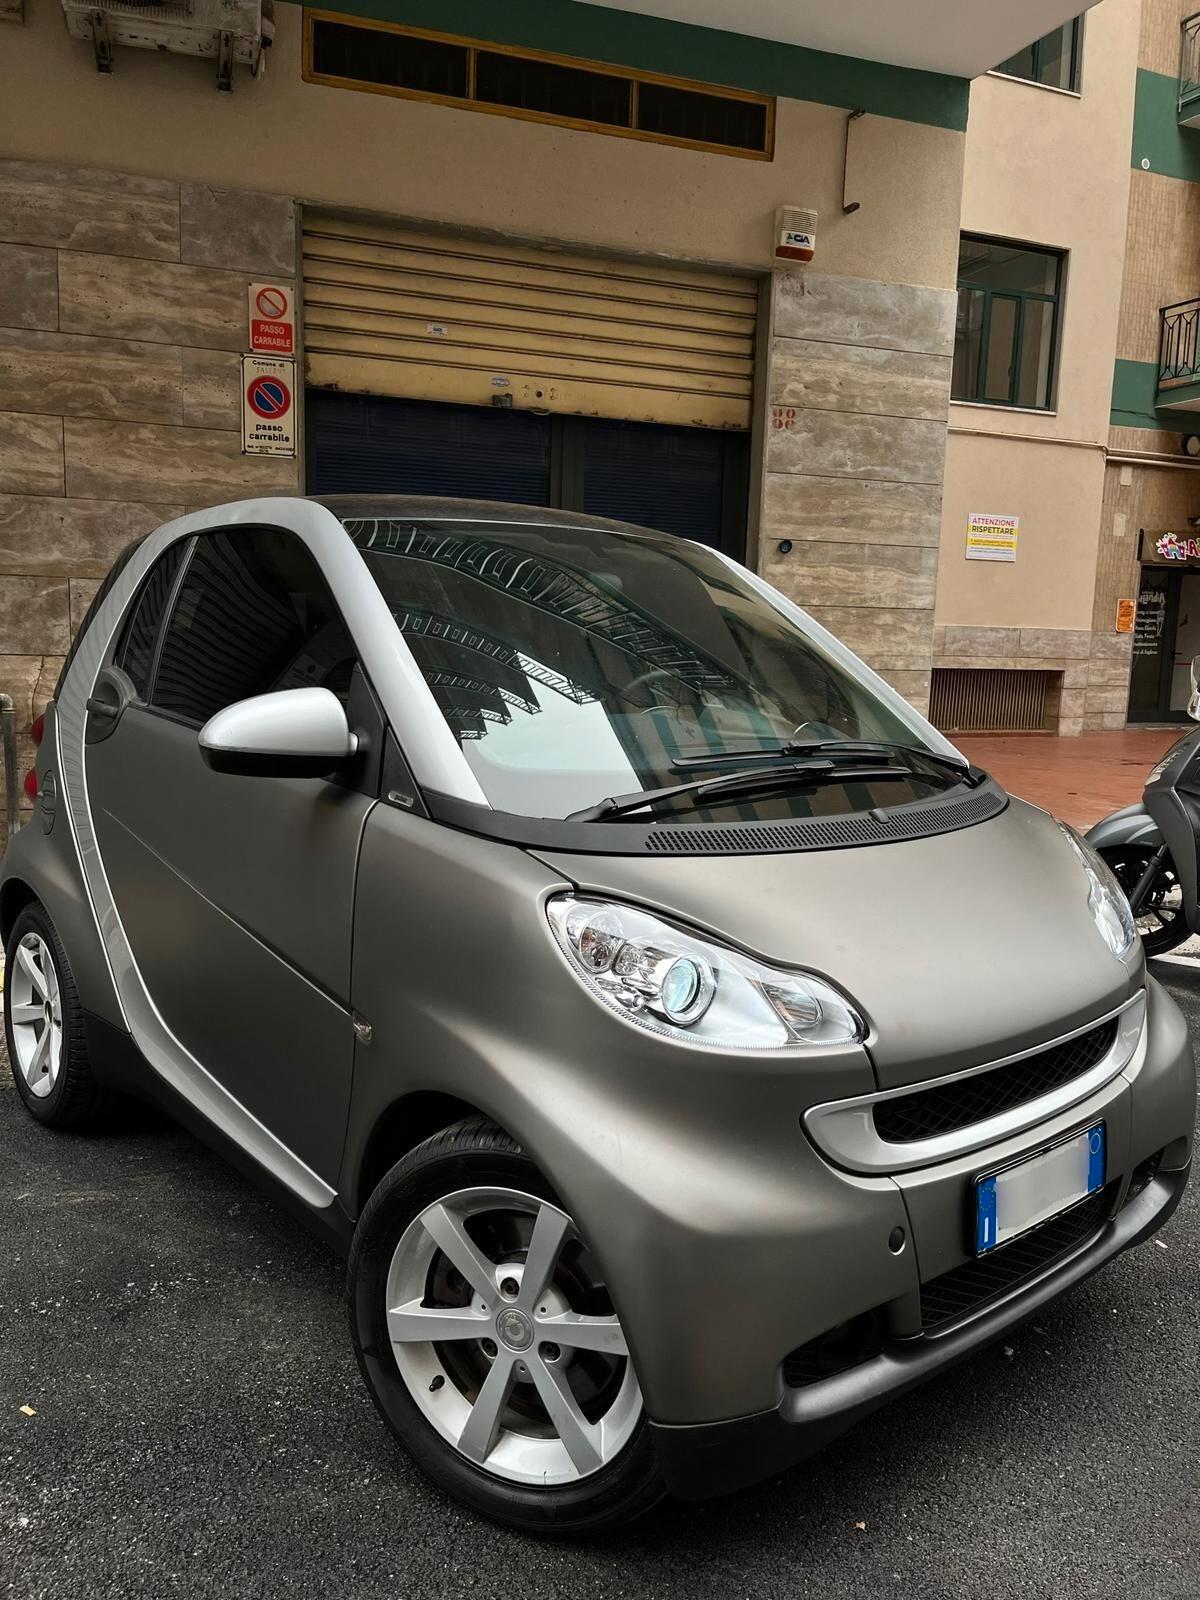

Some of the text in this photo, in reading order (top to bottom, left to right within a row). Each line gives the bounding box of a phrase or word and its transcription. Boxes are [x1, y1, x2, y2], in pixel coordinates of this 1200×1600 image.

[260, 324, 285, 335] PASSO
[253, 335, 291, 348] CARRABILE
[255, 424, 283, 432] passo
[249, 433, 290, 442] carrabile
[972, 517, 1016, 527] ATTENZIONE
[971, 525, 1015, 535] RISPETTARE
